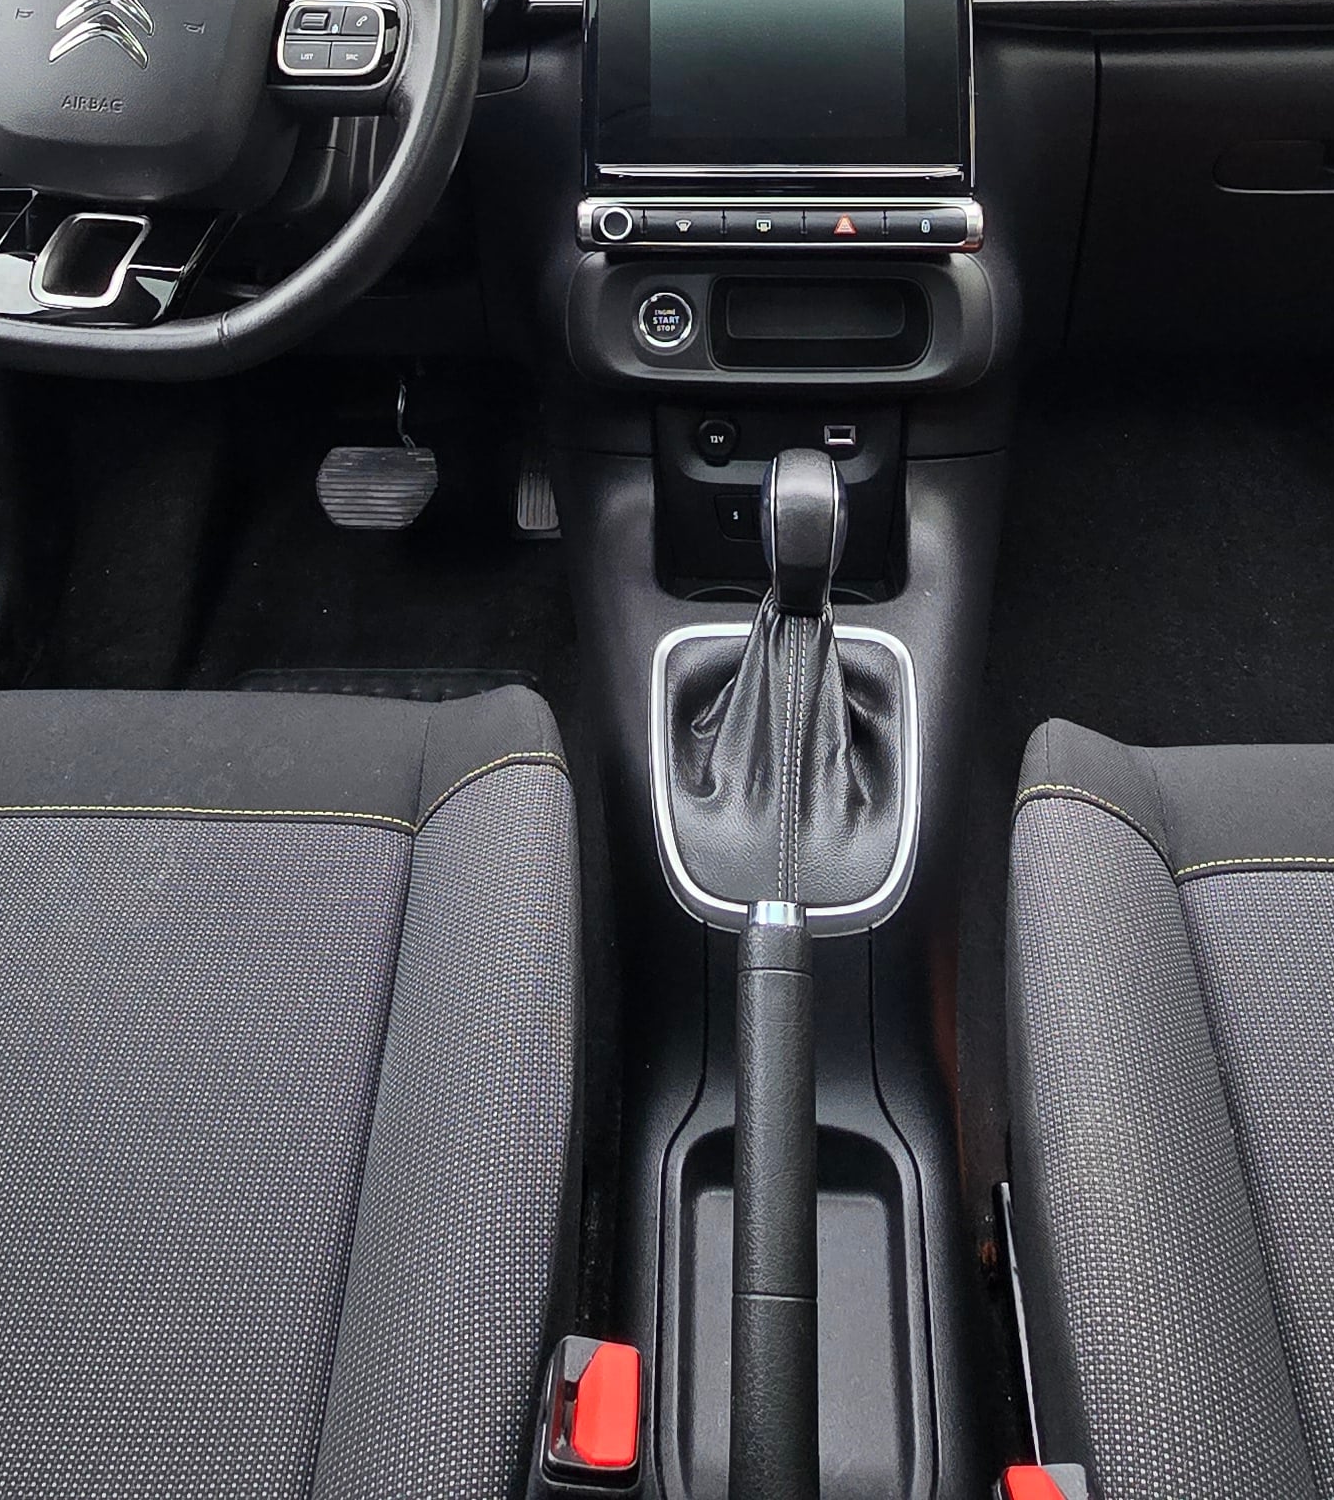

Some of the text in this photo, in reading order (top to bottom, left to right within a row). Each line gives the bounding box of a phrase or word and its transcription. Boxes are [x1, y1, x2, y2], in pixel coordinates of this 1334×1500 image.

[61, 95, 123, 114] AIRBAG
[652, 316, 680, 325] START
[656, 324, 676, 332] STOP
[710, 435, 724, 444] 12V
